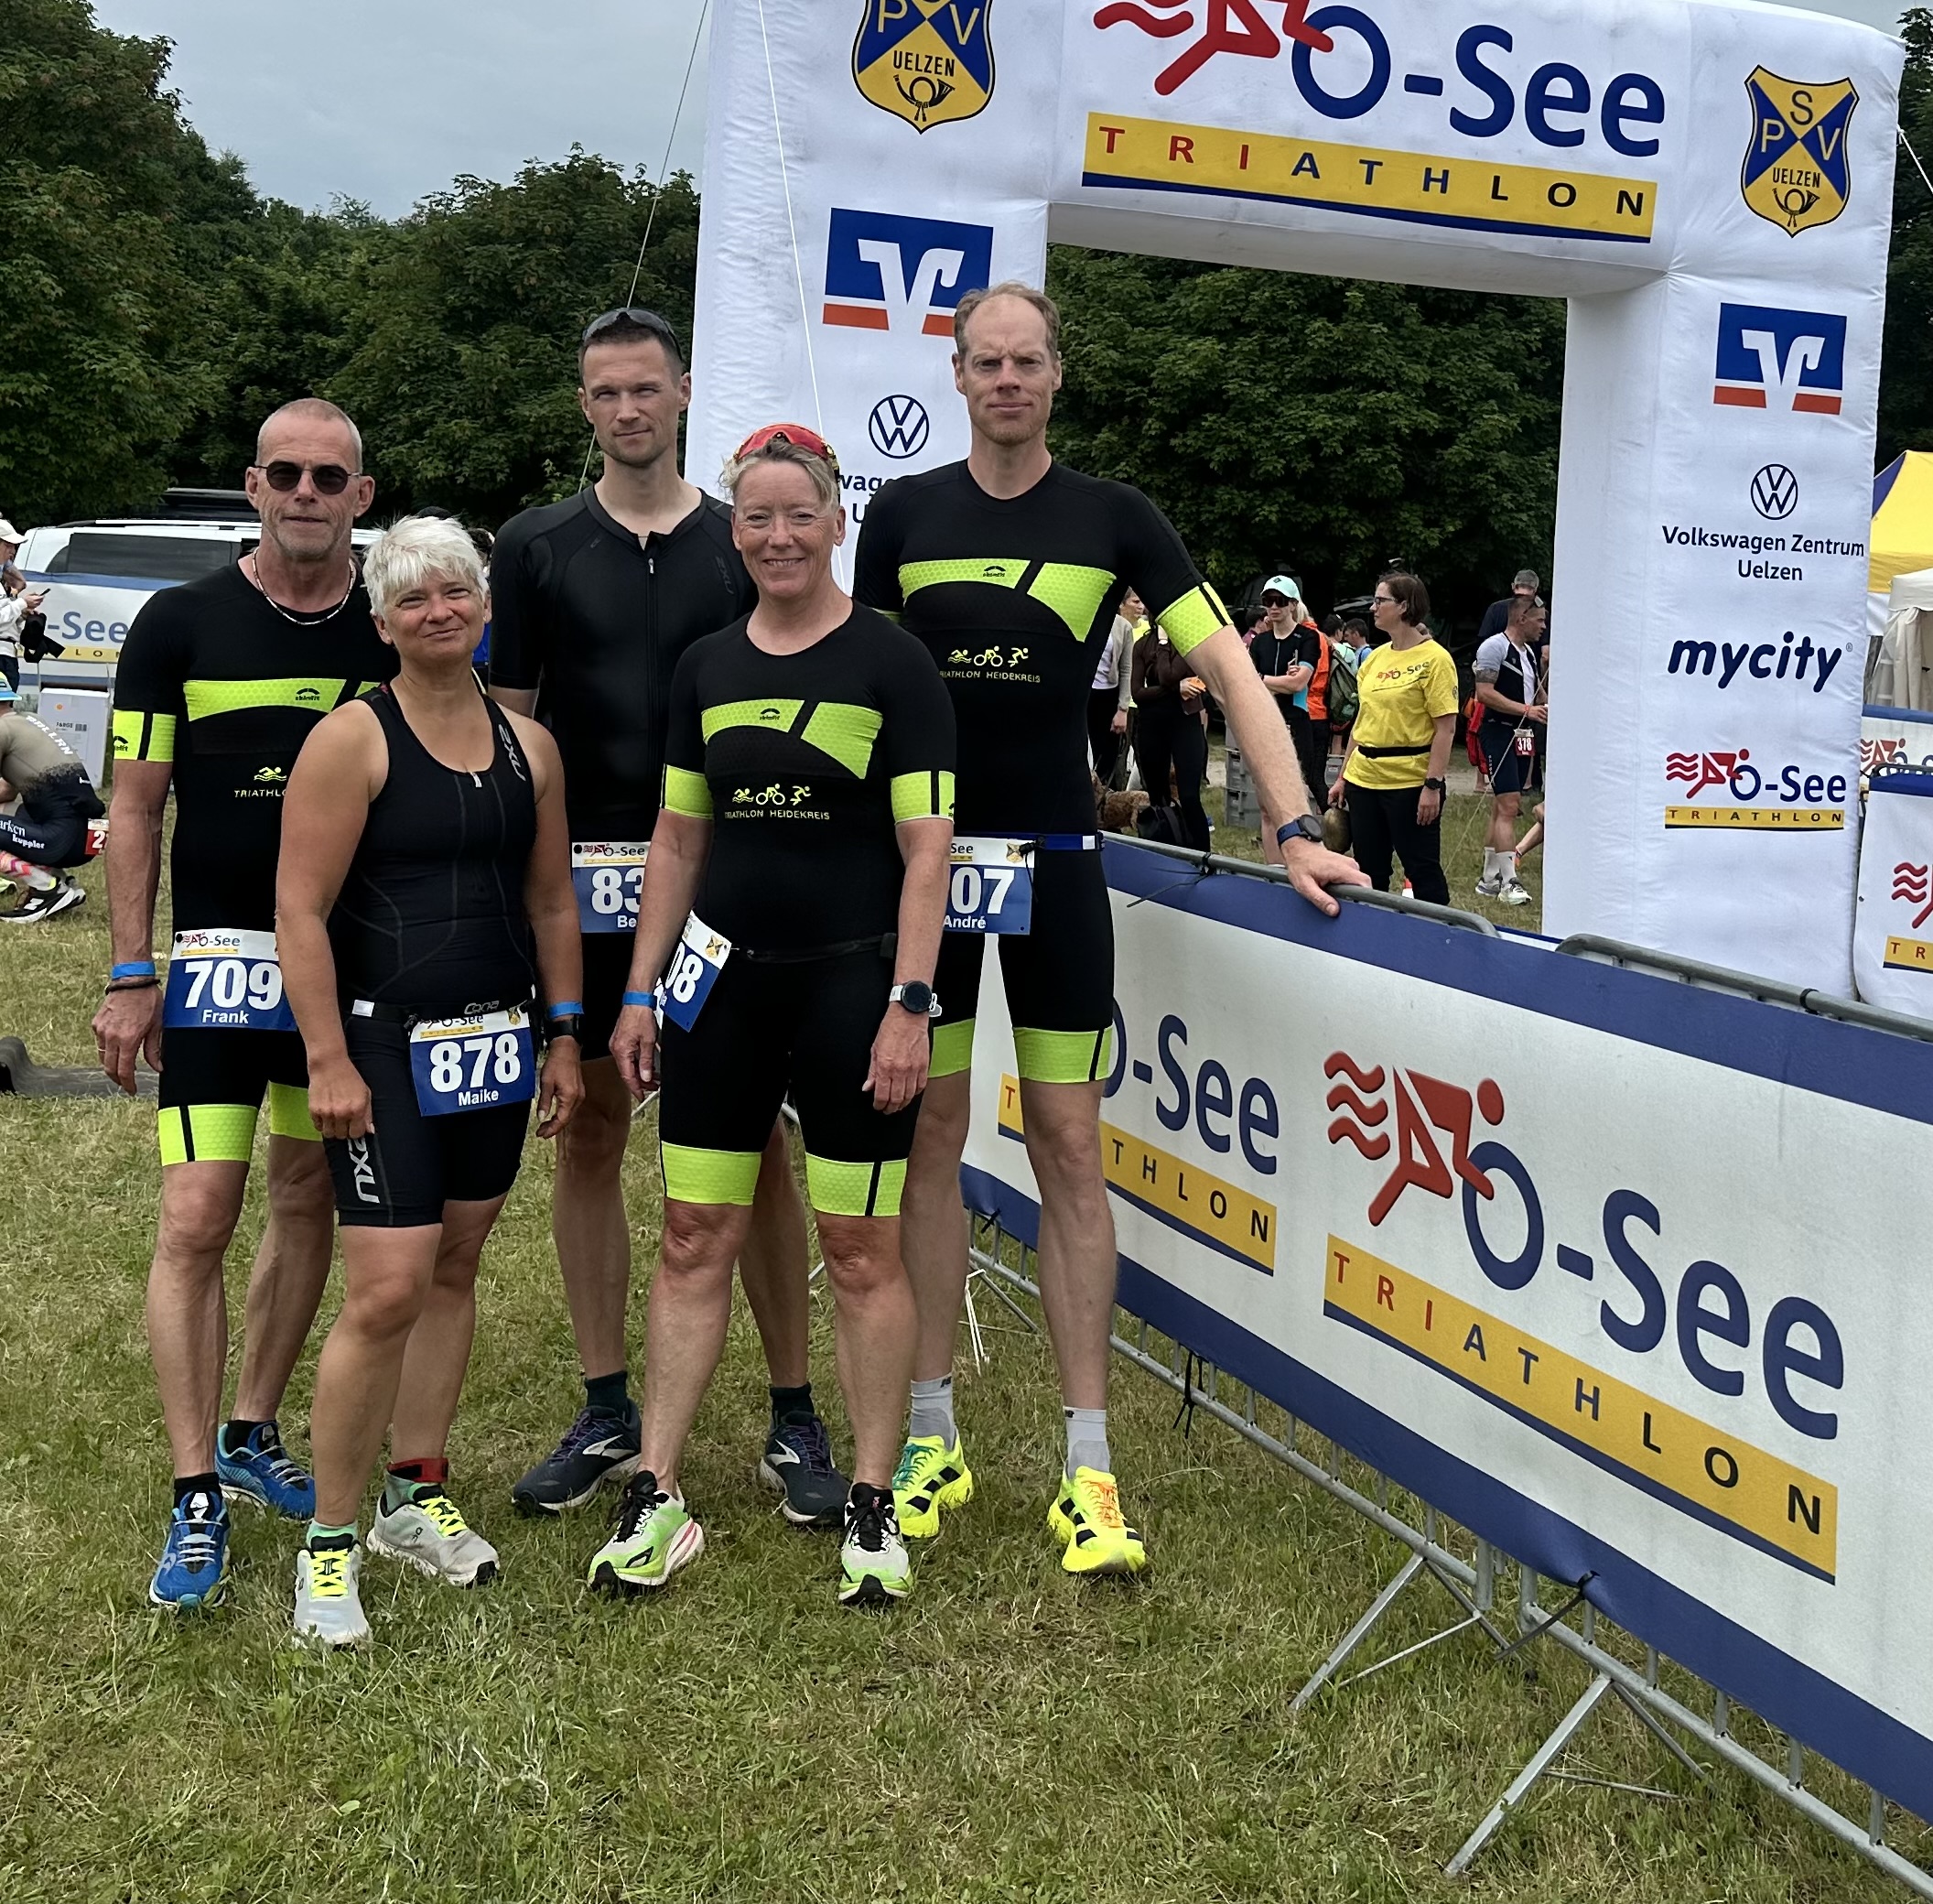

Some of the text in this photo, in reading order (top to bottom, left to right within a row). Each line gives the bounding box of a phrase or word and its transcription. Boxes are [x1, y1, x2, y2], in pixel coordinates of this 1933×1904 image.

[893, 50, 956, 77] UELZEN
[1291, 5, 1665, 157] O-See
[1099, 127, 1644, 216] TRIATHLON
[1772, 167, 1821, 189] UELZEN
[1662, 525, 1864, 557] Volkswagen Zentrum
[1738, 559, 1803, 580] Uelzen
[47, 611, 129, 644] -See
[939, 670, 1041, 683] RIATHLON HEIDEKREIS
[498, 723, 526, 782] 2XU
[1517, 737, 1532, 752] 378
[234, 788, 286, 798] TRIATHLO
[1729, 764, 1847, 803] O-See
[770, 809, 830, 820] HEIDEKREIS
[1668, 809, 1841, 823] TRIATHLON
[950, 842, 974, 854] See
[591, 868, 645, 914] 83
[951, 866, 1015, 914] 07
[617, 914, 637, 928] Be
[943, 914, 987, 929] André
[185, 959, 283, 1011] 709
[664, 941, 704, 1003] 08
[202, 1009, 250, 1024] Frank
[430, 1033, 521, 1093] 878
[458, 1088, 499, 1107] Maike
[1005, 1085, 1269, 1243] TTHLON
[1462, 1141, 1844, 1440] O-See
[1333, 1250, 1821, 1535] TRIATHLON
